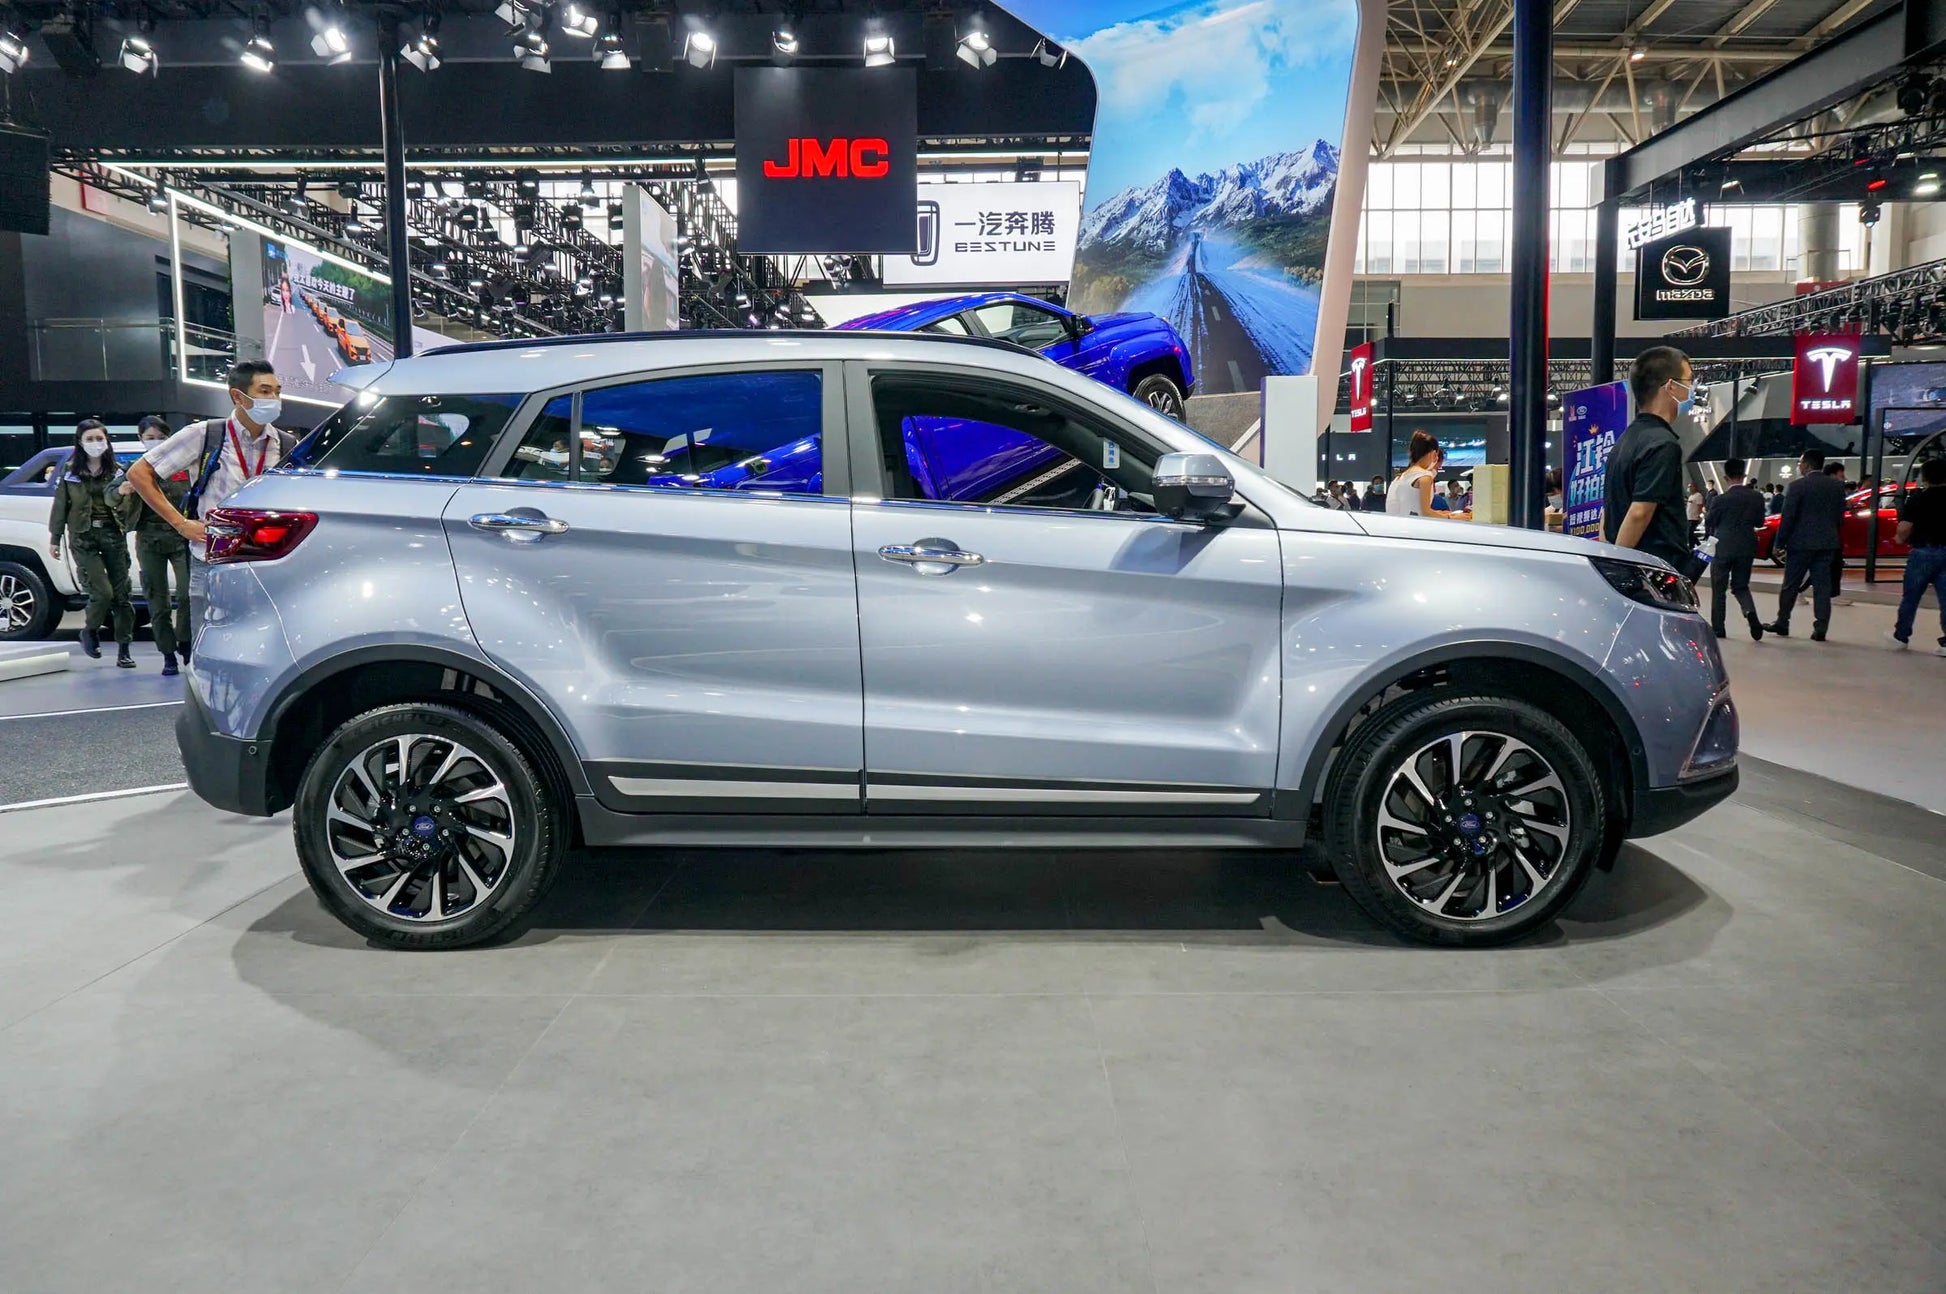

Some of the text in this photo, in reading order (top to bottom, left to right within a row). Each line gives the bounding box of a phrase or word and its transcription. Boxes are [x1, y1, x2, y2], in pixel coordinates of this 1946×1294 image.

[763, 138, 889, 178] JMC
[954, 211, 1056, 236] 一汽奔腾
[954, 241, 1056, 253] BESTUNE
[1351, 407, 1367, 418] TESLA
[1801, 400, 1852, 409] TESLA
[1575, 430, 1616, 477] 江铃
